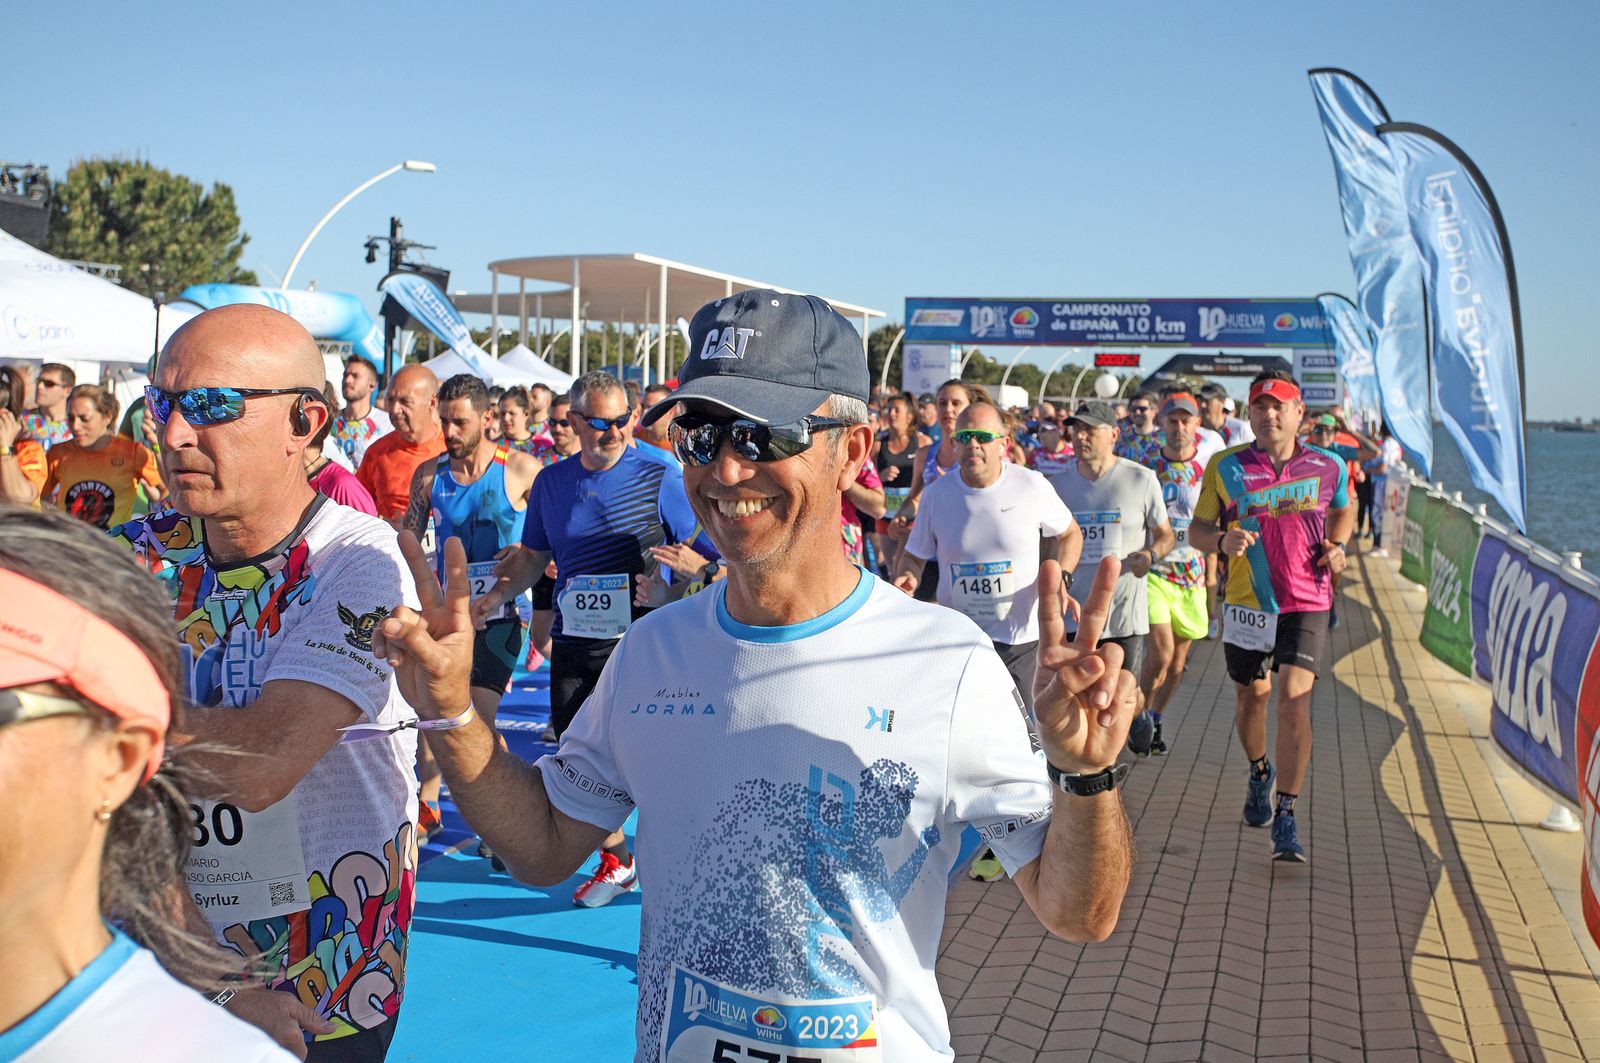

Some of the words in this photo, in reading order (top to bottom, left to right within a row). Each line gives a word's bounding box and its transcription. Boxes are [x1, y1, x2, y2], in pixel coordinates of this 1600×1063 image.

[1052, 303, 1151, 316] CAMPEONATO
[1050, 318, 1067, 330] de
[1069, 317, 1119, 331] ESPAÑA
[1127, 317, 1150, 333] 10
[1155, 316, 1186, 333] km
[1226, 314, 1265, 329] HUELVA
[701, 326, 754, 360] CAT
[602, 579, 621, 588] 2023
[959, 578, 1001, 594] 1481
[575, 594, 611, 610] 829
[1231, 608, 1266, 629] 1003
[336, 647, 347, 656] de
[349, 651, 366, 665] Beni
[655, 687, 700, 698] Muebles
[630, 703, 716, 715] JORMA
[206, 871, 253, 884] GARCIA
[194, 892, 240, 909] Syrluz
[705, 996, 748, 1023] HUELVA
[756, 1026, 783, 1041] WiHu
[798, 1013, 860, 1041] 2023
